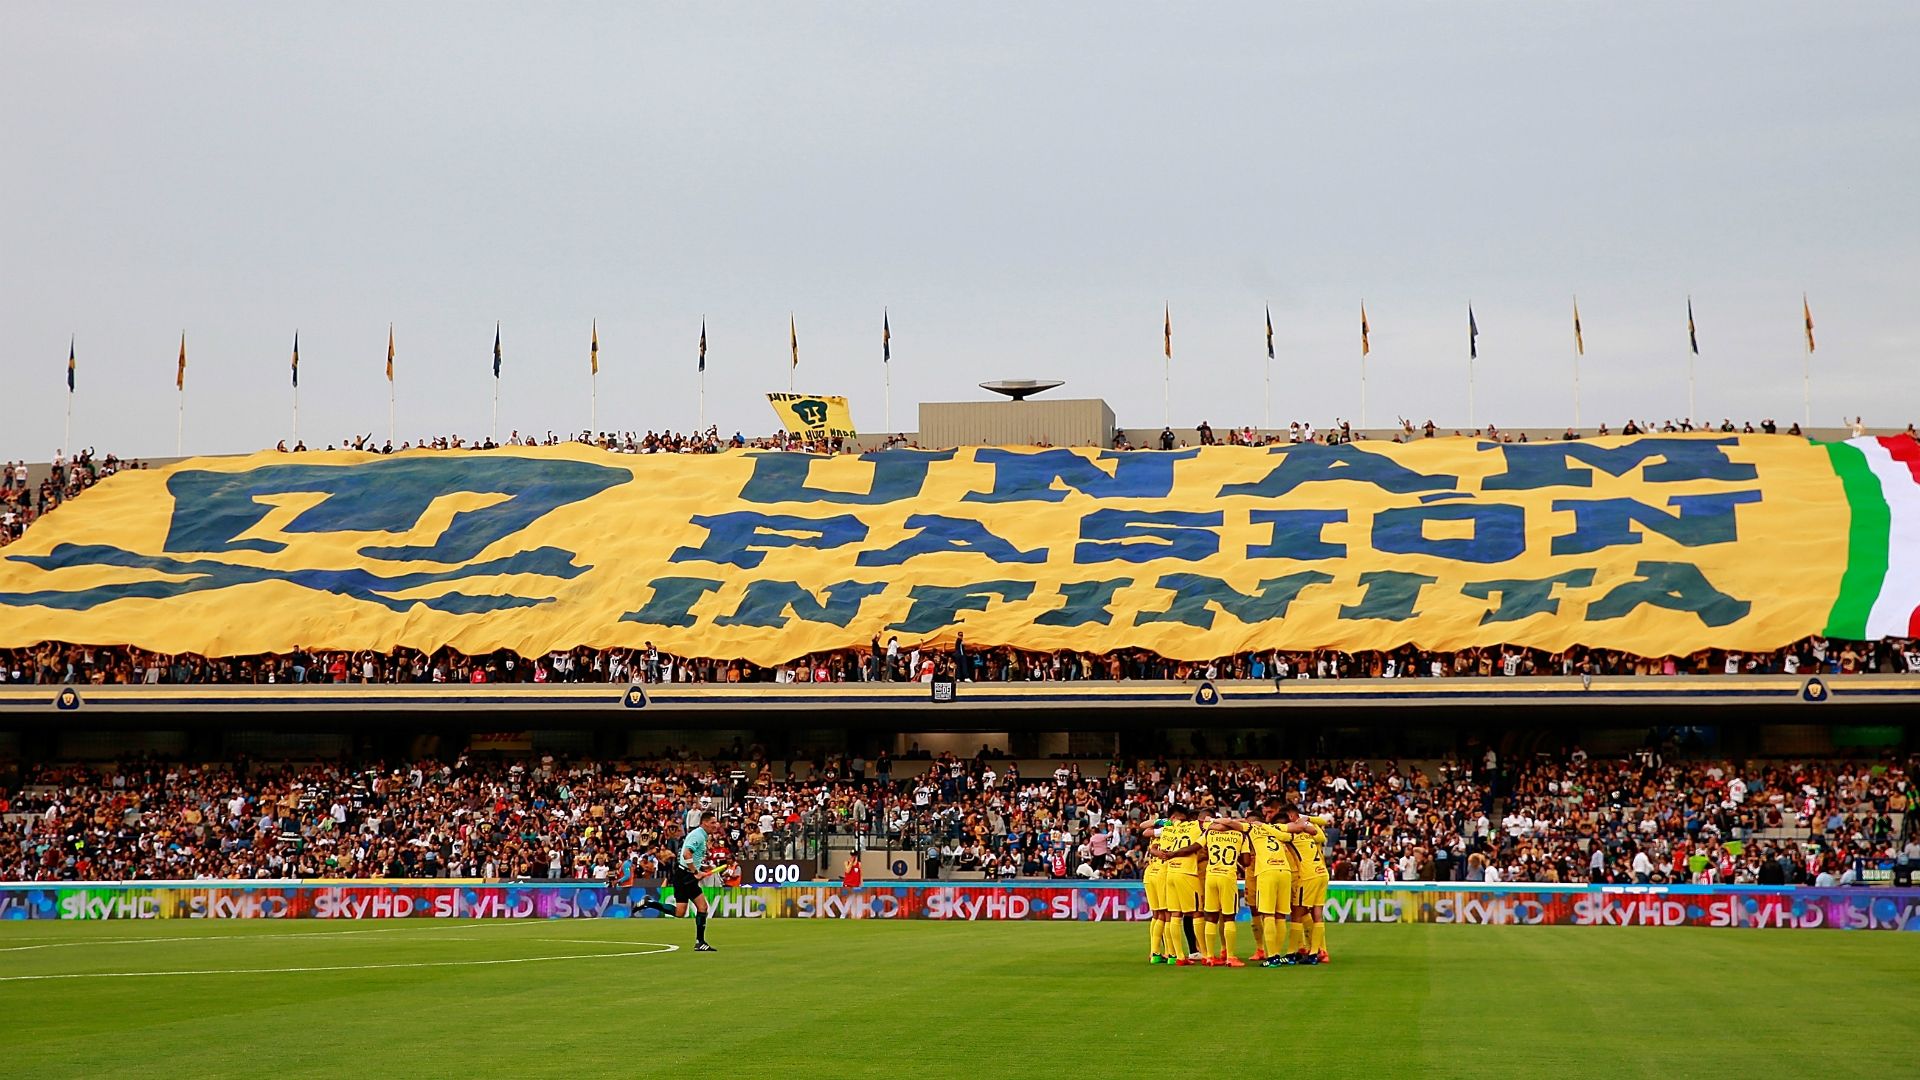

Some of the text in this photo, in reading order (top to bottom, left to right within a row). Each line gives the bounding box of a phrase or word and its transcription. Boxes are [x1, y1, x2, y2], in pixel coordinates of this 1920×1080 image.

[830, 428, 857, 439] NADA
[738, 437, 1758, 505] UNAM
[668, 490, 1762, 569] PASIÓN
[618, 562, 1752, 632] INFINITA
[1267, 835, 1280, 852] 5
[1209, 844, 1237, 866] 30
[754, 864, 800, 883] 0:00
